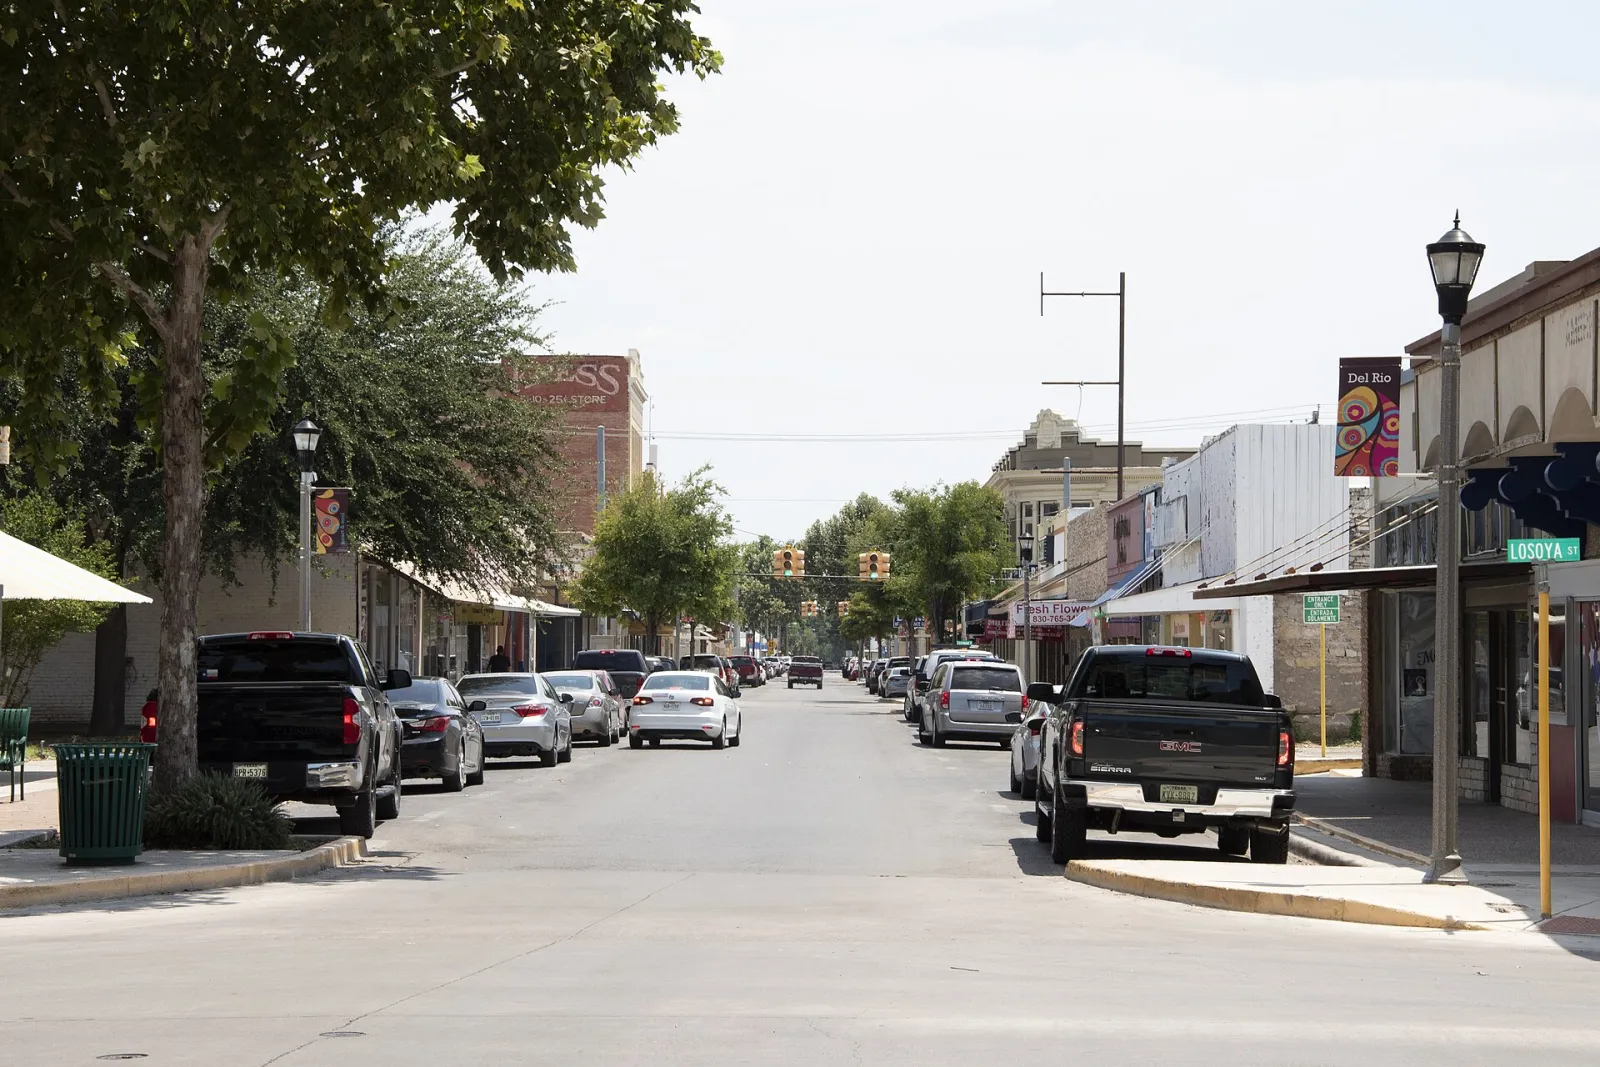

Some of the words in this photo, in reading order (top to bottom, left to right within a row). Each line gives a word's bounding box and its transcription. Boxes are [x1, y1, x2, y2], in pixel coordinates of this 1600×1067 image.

[1347, 372, 1369, 384] Del
[1372, 372, 1392, 384] Rio
[570, 395, 607, 404] STORE
[1510, 543, 1563, 560] LOSOYA
[1567, 546, 1578, 555] ST
[1016, 604, 1049, 614] Fesh
[1053, 604, 1090, 614] Flowe
[1160, 739, 1202, 753] GMC
[1090, 766, 1132, 774] SIERRA
